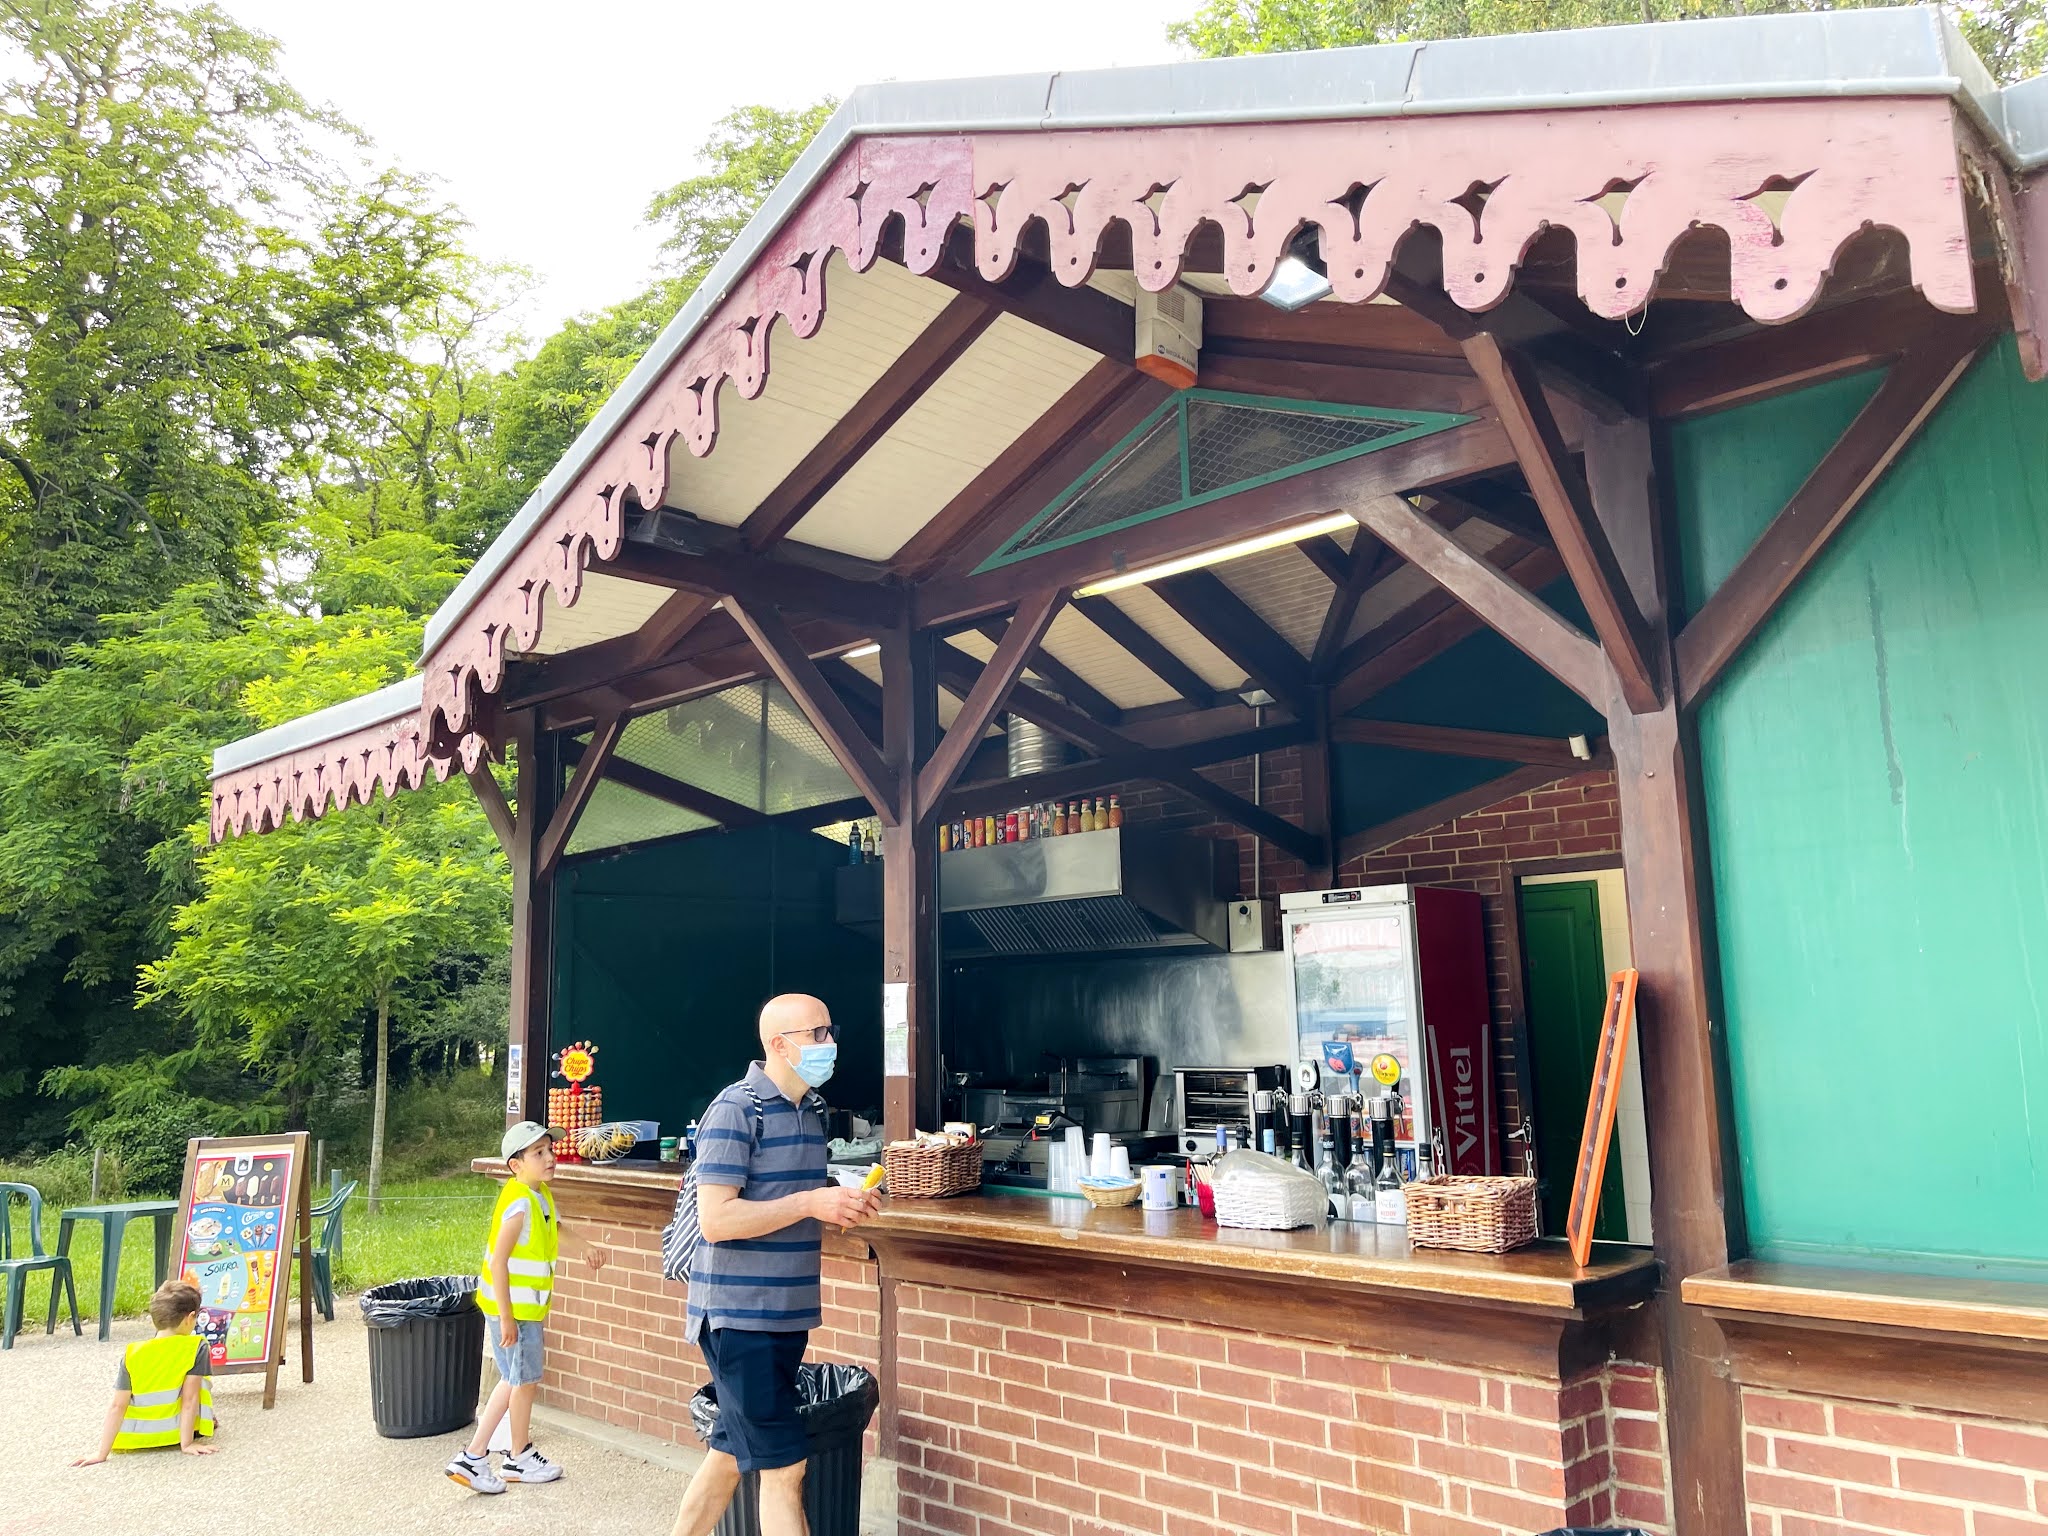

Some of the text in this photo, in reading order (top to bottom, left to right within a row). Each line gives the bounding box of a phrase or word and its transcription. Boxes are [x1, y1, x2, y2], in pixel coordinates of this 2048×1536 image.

[566, 1057, 589, 1066] Chupa
[564, 1064, 587, 1077] Chups
[1450, 1044, 1478, 1162] Vittel
[221, 1178, 230, 1186] M
